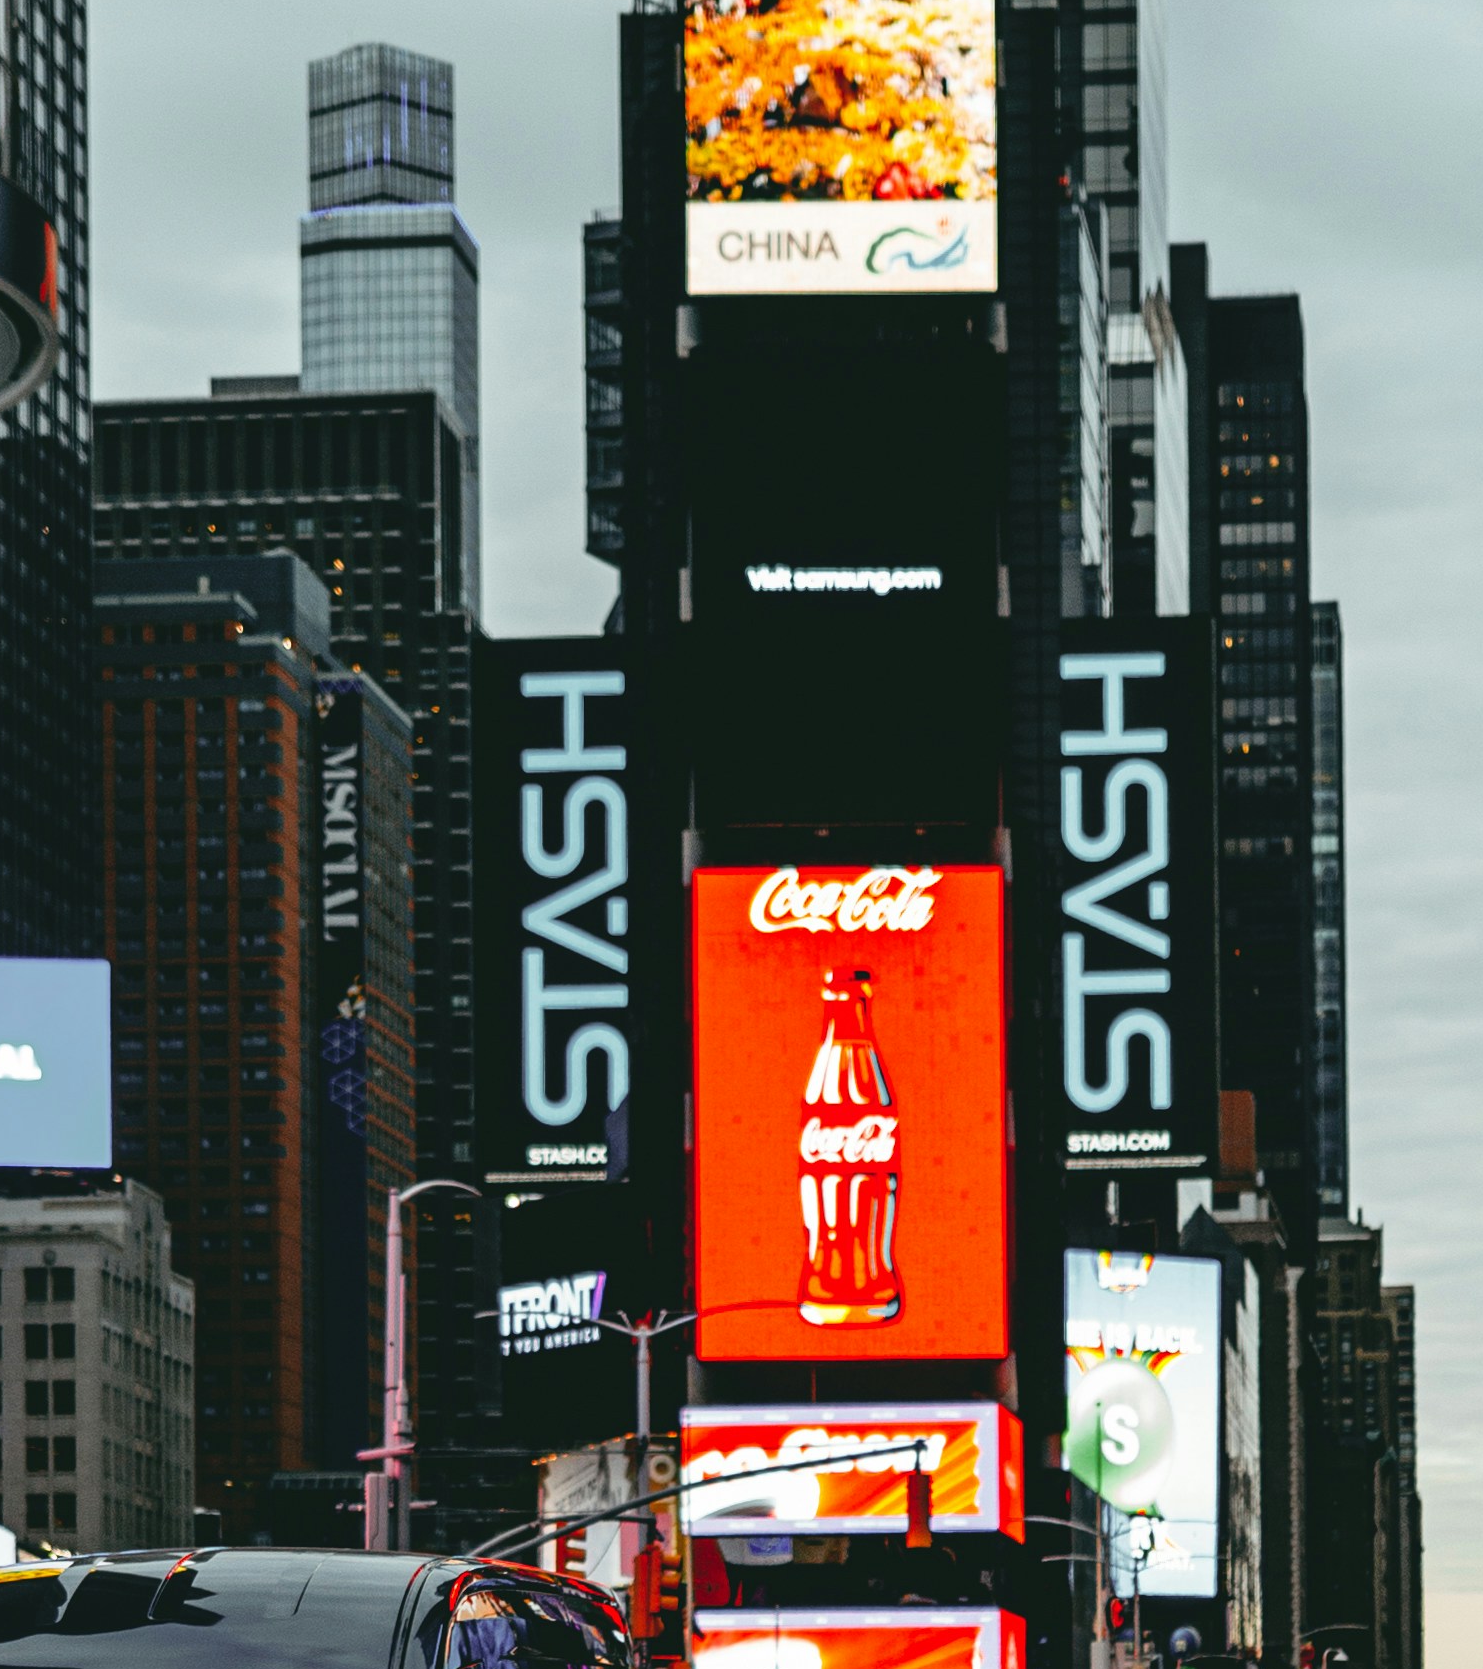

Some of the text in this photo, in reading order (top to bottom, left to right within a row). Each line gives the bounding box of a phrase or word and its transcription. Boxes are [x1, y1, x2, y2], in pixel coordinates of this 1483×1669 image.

[718, 231, 841, 263] CHINA
[793, 567, 943, 595] samsung.com
[520, 672, 629, 1127] STASH
[749, 864, 943, 933] Coca-Cola
[1061, 652, 1172, 1113] STASH
[1067, 1132, 1171, 1153] STASH.COM
[1101, 1403, 1140, 1466] S
